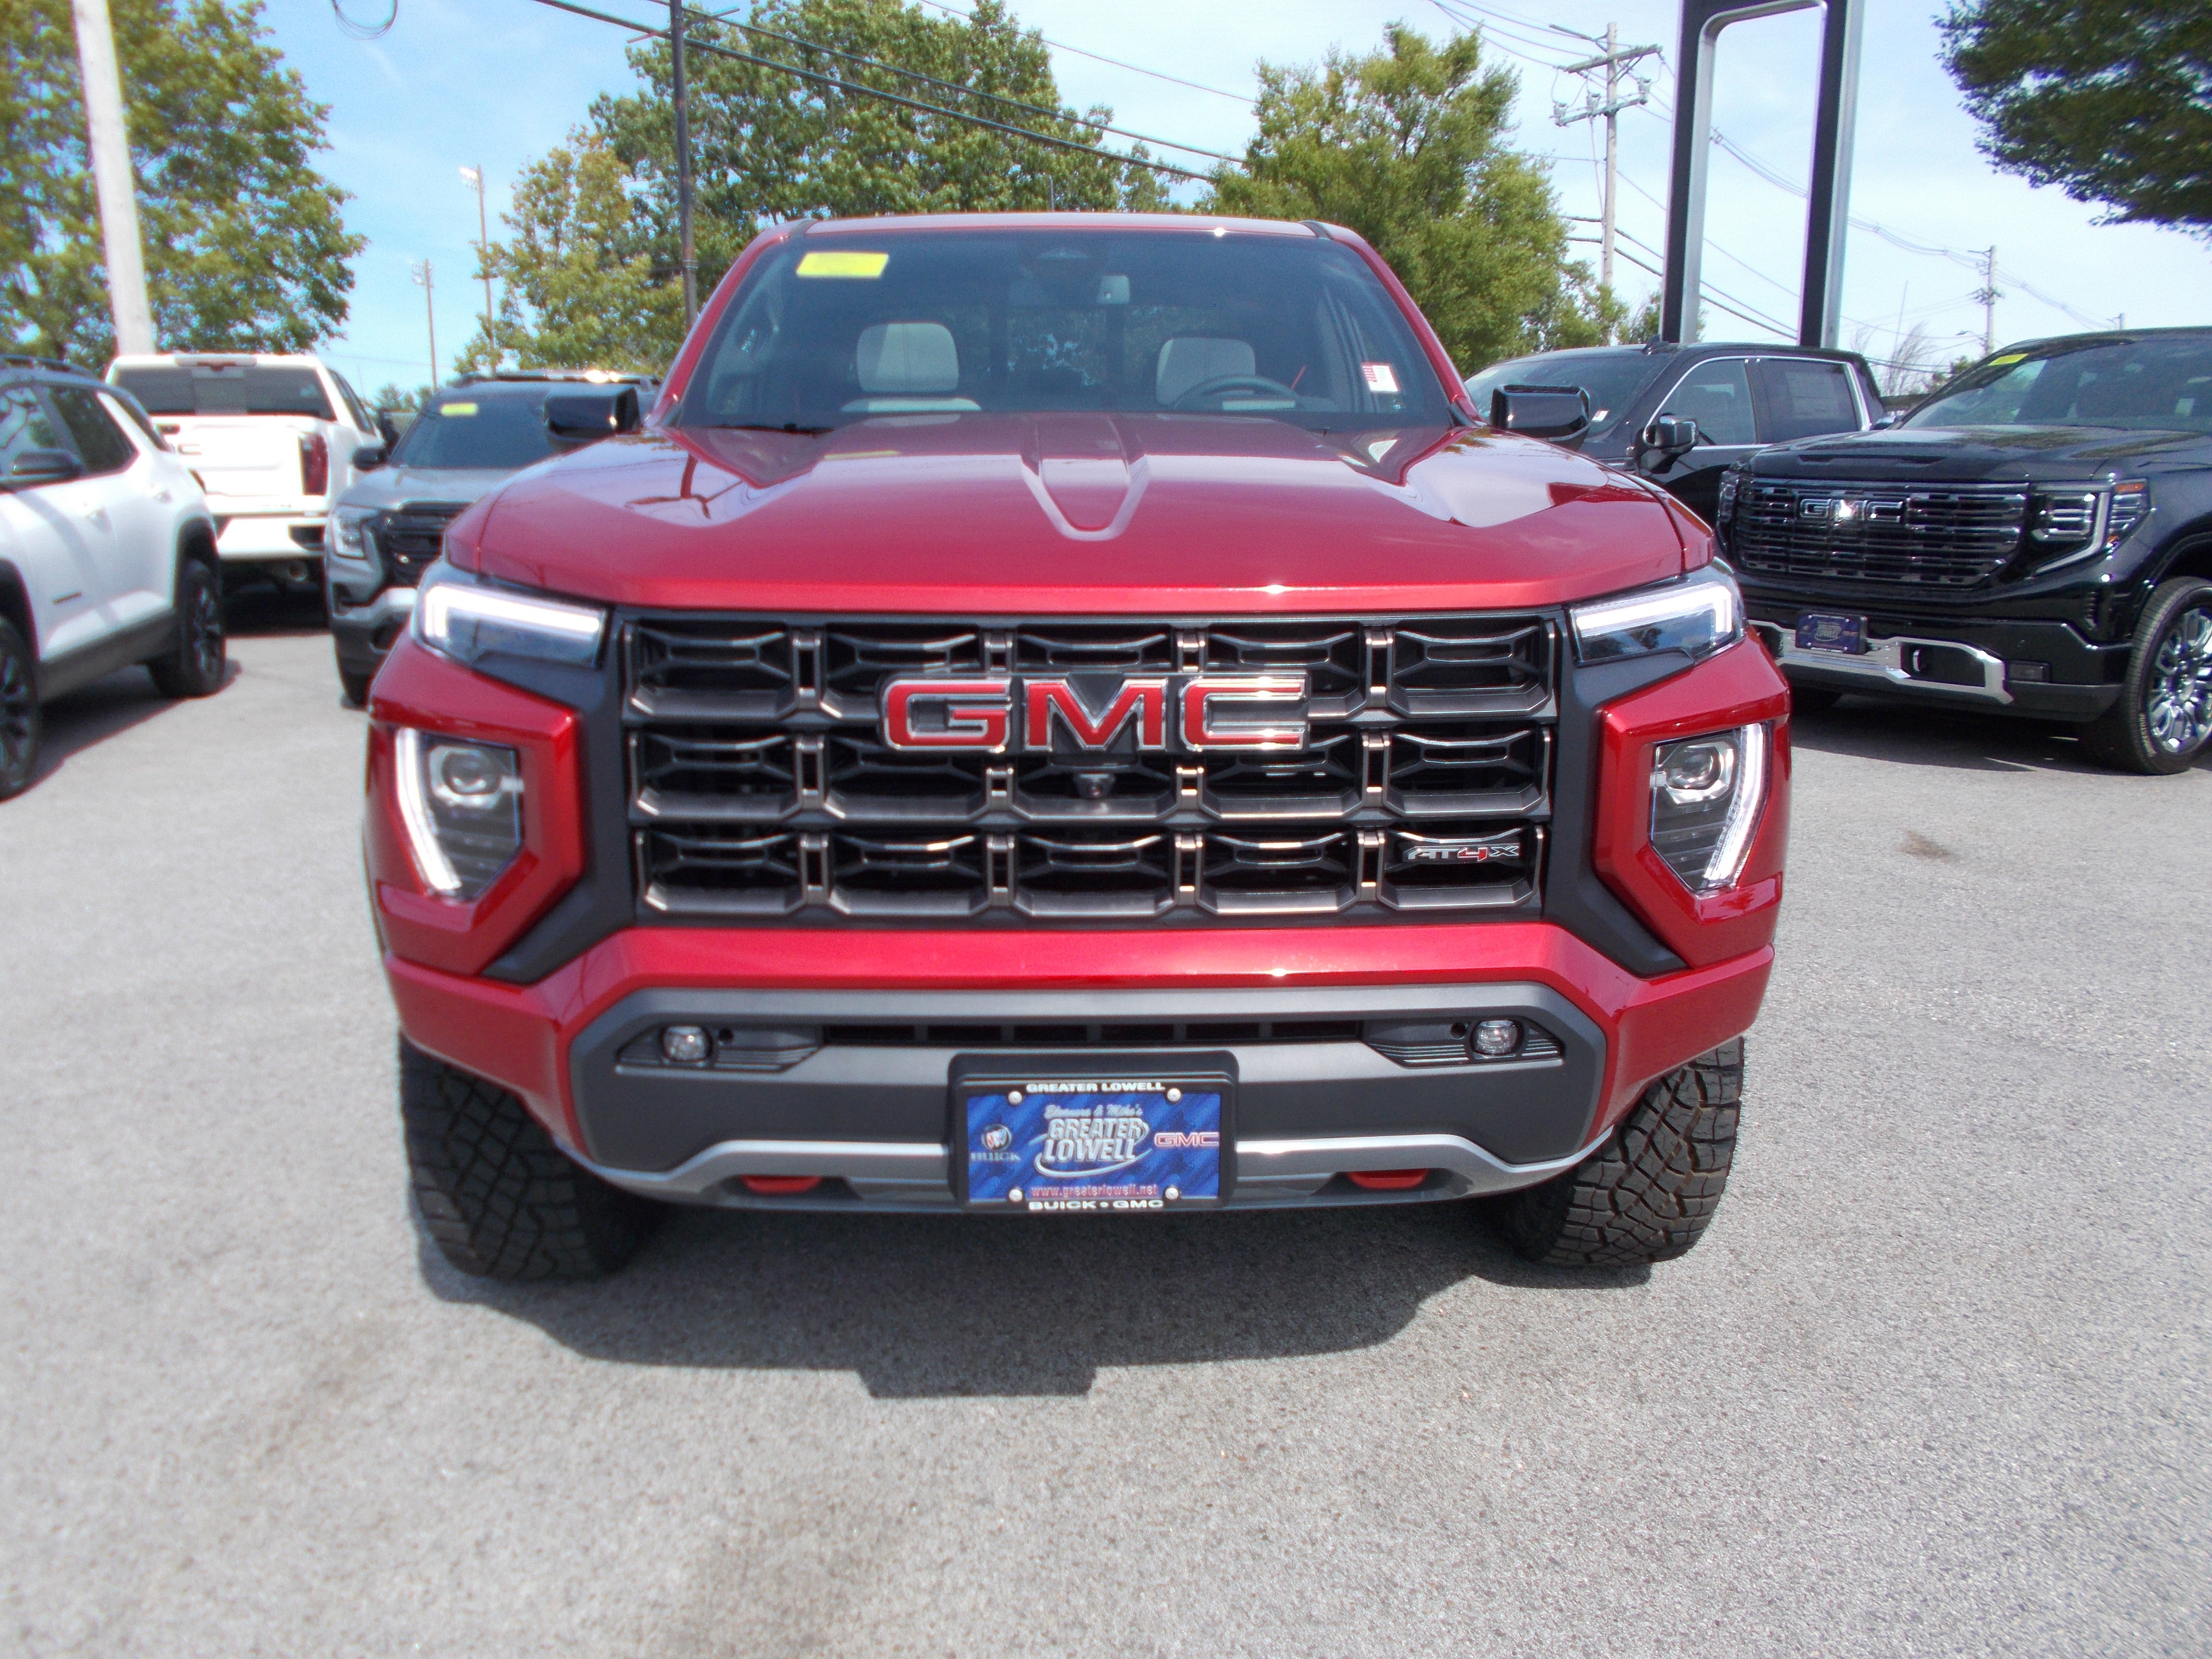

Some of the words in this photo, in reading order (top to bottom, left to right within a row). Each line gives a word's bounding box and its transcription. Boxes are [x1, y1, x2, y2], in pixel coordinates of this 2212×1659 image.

[882, 677, 1308, 753] GMC
[1407, 845, 1520, 862] AT4X
[1026, 1083, 1098, 1093] GREATER
[1101, 1082, 1166, 1092] LOWELL
[1048, 1118, 1142, 1139] GREATER
[1154, 1131, 1220, 1147] GMC
[1042, 1138, 1136, 1163] LOWELL
[1030, 1184, 1159, 1198] www.greaterlowell.net
[1028, 1201, 1097, 1211] BUICK
[1113, 1200, 1164, 1209] GMC
